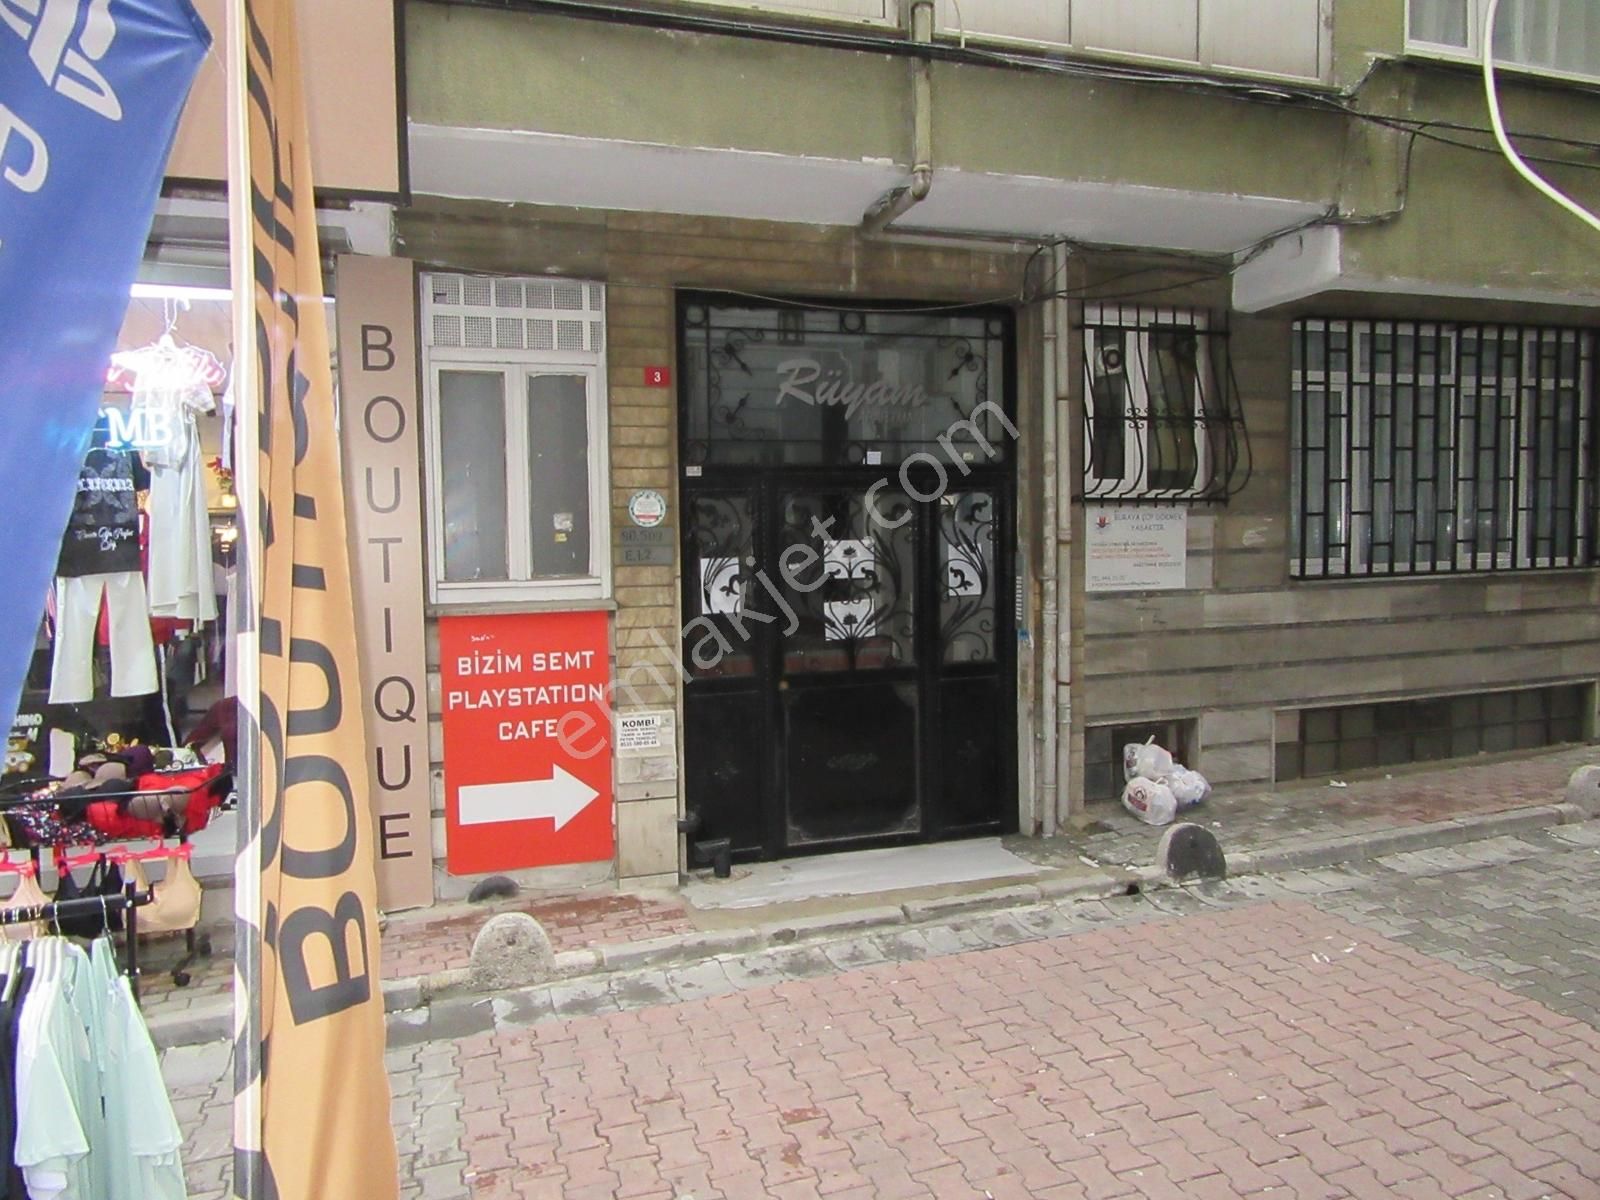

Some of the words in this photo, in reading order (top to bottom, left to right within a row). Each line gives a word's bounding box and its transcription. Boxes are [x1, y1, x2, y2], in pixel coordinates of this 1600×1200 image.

[653, 371, 662, 382] 3
[775, 358, 928, 421] Rüyam
[360, 323, 417, 860] BOUTIQUE
[457, 649, 522, 676] BİZİM
[532, 651, 595, 672] SEMT
[449, 683, 604, 710] PLAYSTATION
[498, 719, 558, 741] CAFE
[622, 717, 655, 728] KOMBİ
